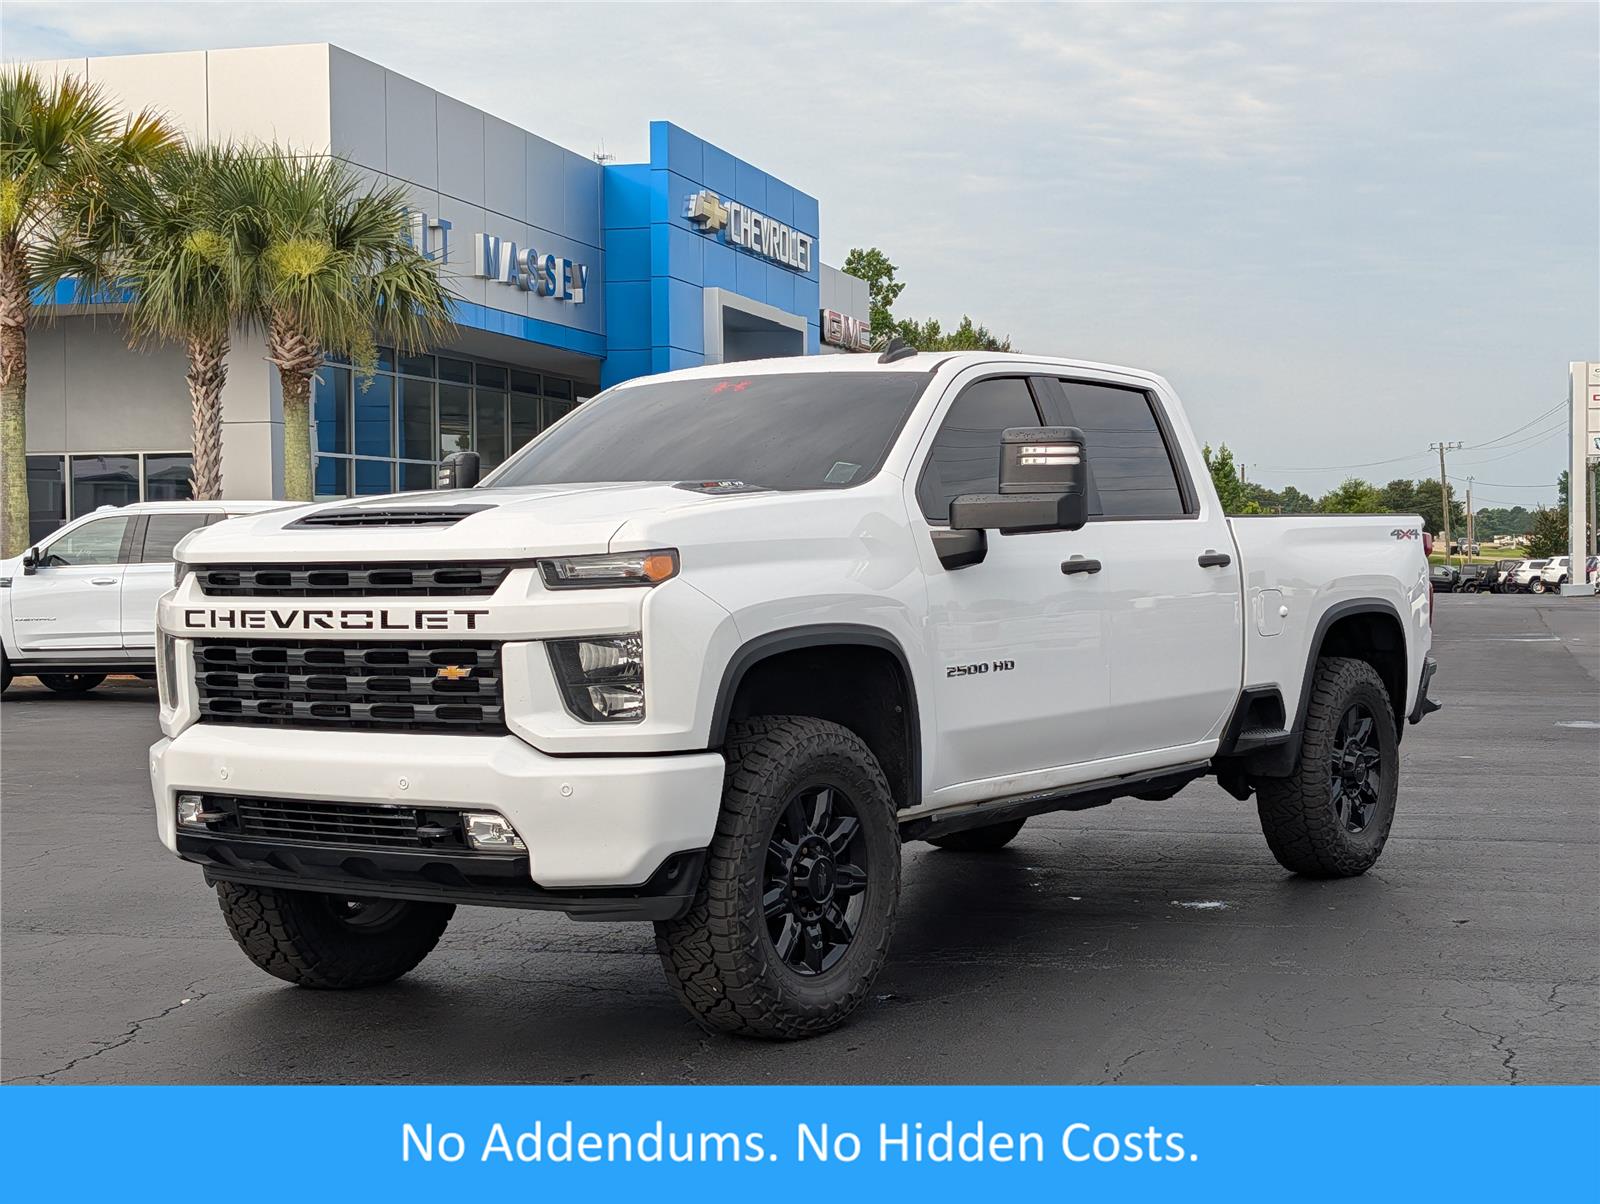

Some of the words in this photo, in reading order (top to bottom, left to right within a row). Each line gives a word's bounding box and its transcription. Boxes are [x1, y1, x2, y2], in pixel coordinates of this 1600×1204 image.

[725, 201, 813, 273] CHEVROLET
[474, 232, 588, 304] MASSEY
[823, 308, 871, 352] GMC
[184, 609, 490, 630] CHEVROLET
[946, 663, 989, 678] 2500
[992, 660, 1015, 672] HD
